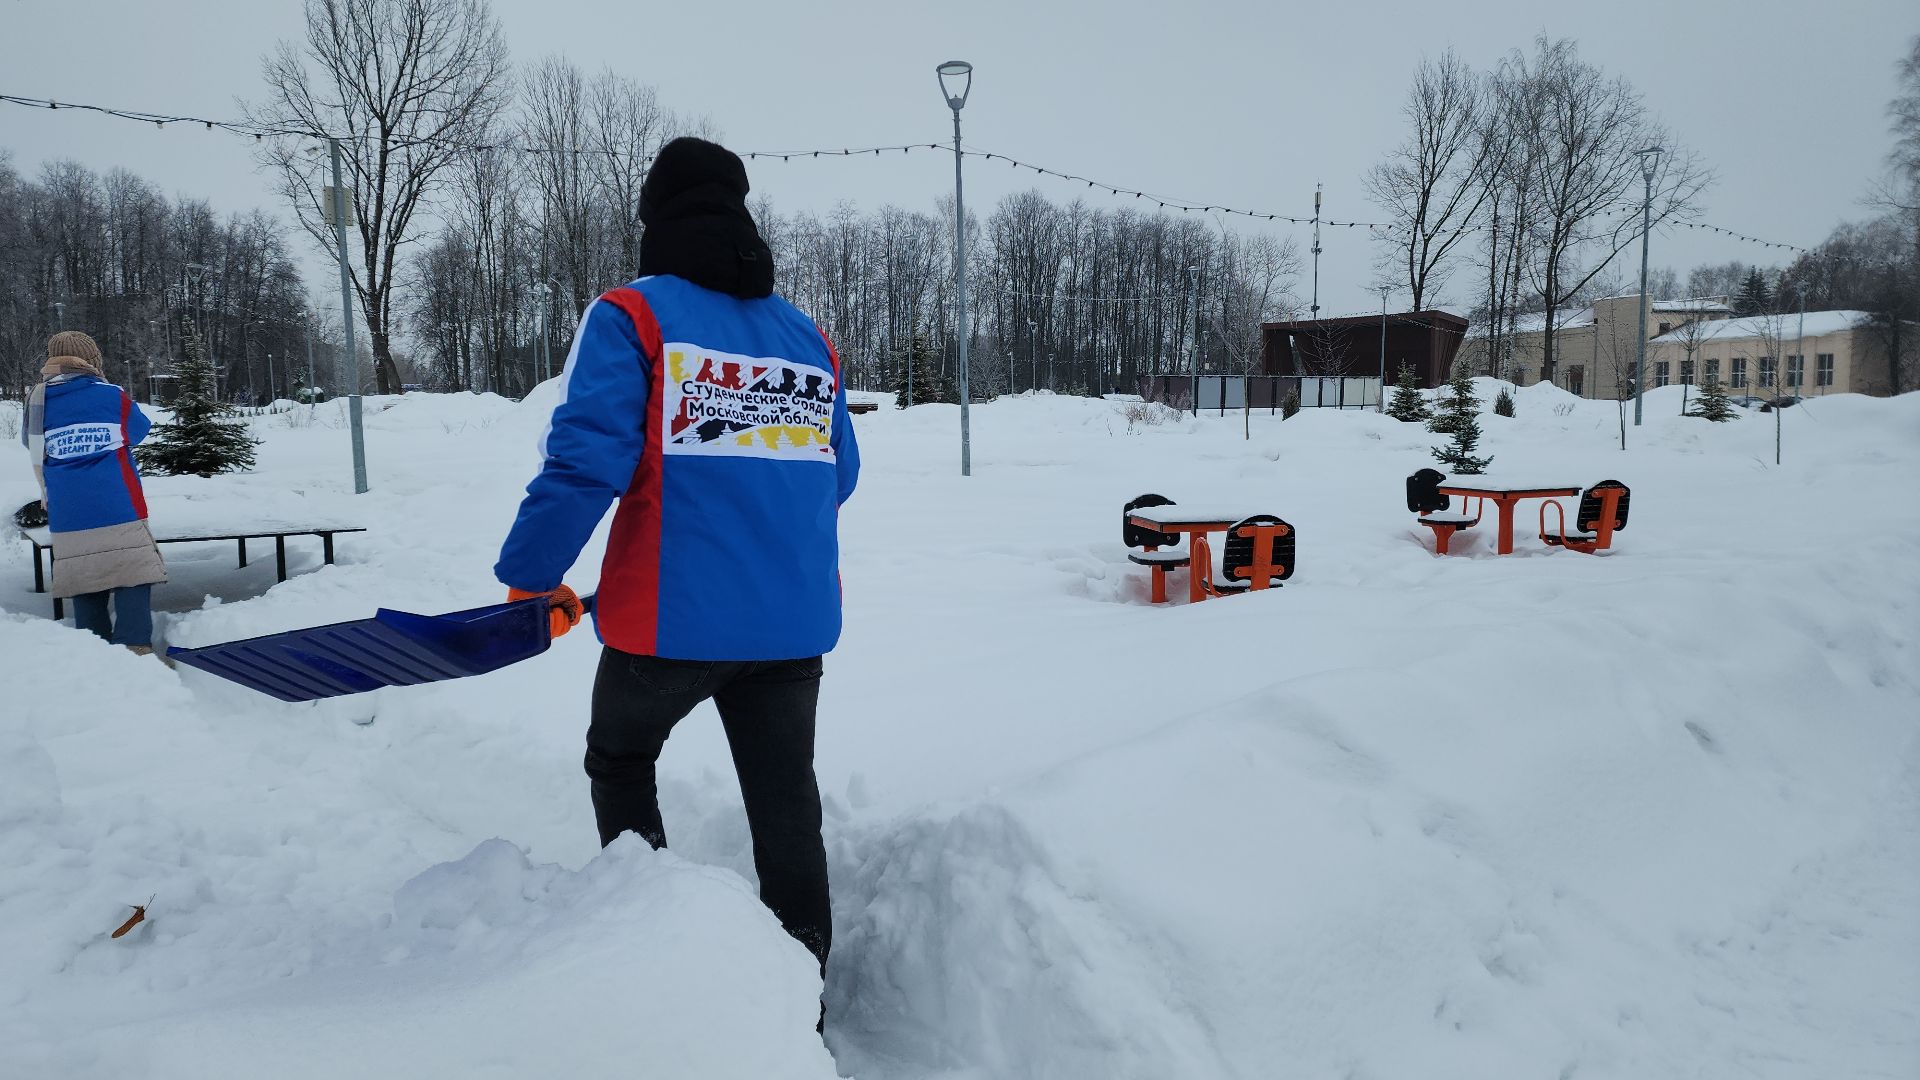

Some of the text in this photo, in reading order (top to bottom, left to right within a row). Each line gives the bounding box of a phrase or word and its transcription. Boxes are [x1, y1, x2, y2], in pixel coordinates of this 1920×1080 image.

[682, 380, 830, 417] Студенческие оряды
[689, 402, 826, 434] Московской облти
[57, 432, 111, 447] СНЕЖНЫЙ
[58, 444, 92, 456] ДЕСАНТ
